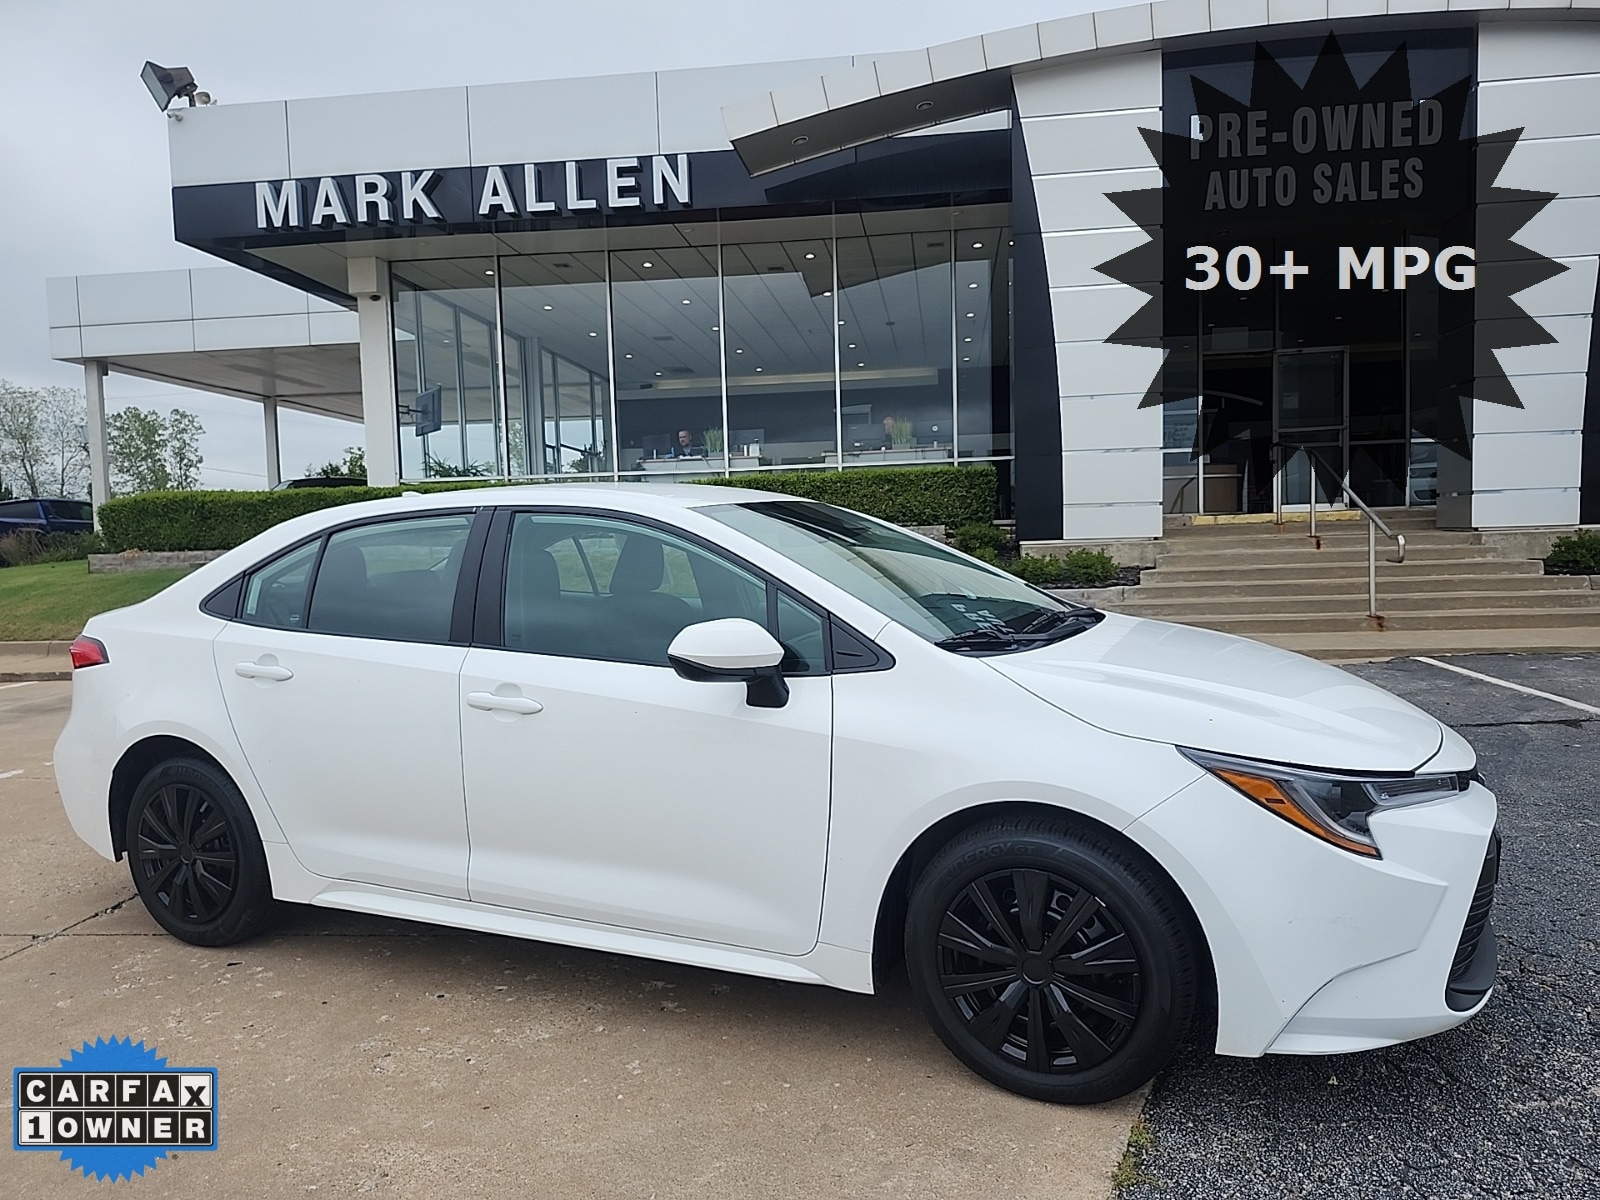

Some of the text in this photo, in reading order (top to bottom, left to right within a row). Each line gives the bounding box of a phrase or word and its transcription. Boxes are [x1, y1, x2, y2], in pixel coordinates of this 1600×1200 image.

[1190, 99, 1443, 160] PRE-OWNED
[255, 154, 692, 229] MARK ALLEN
[1204, 157, 1424, 211] AUTO SALES
